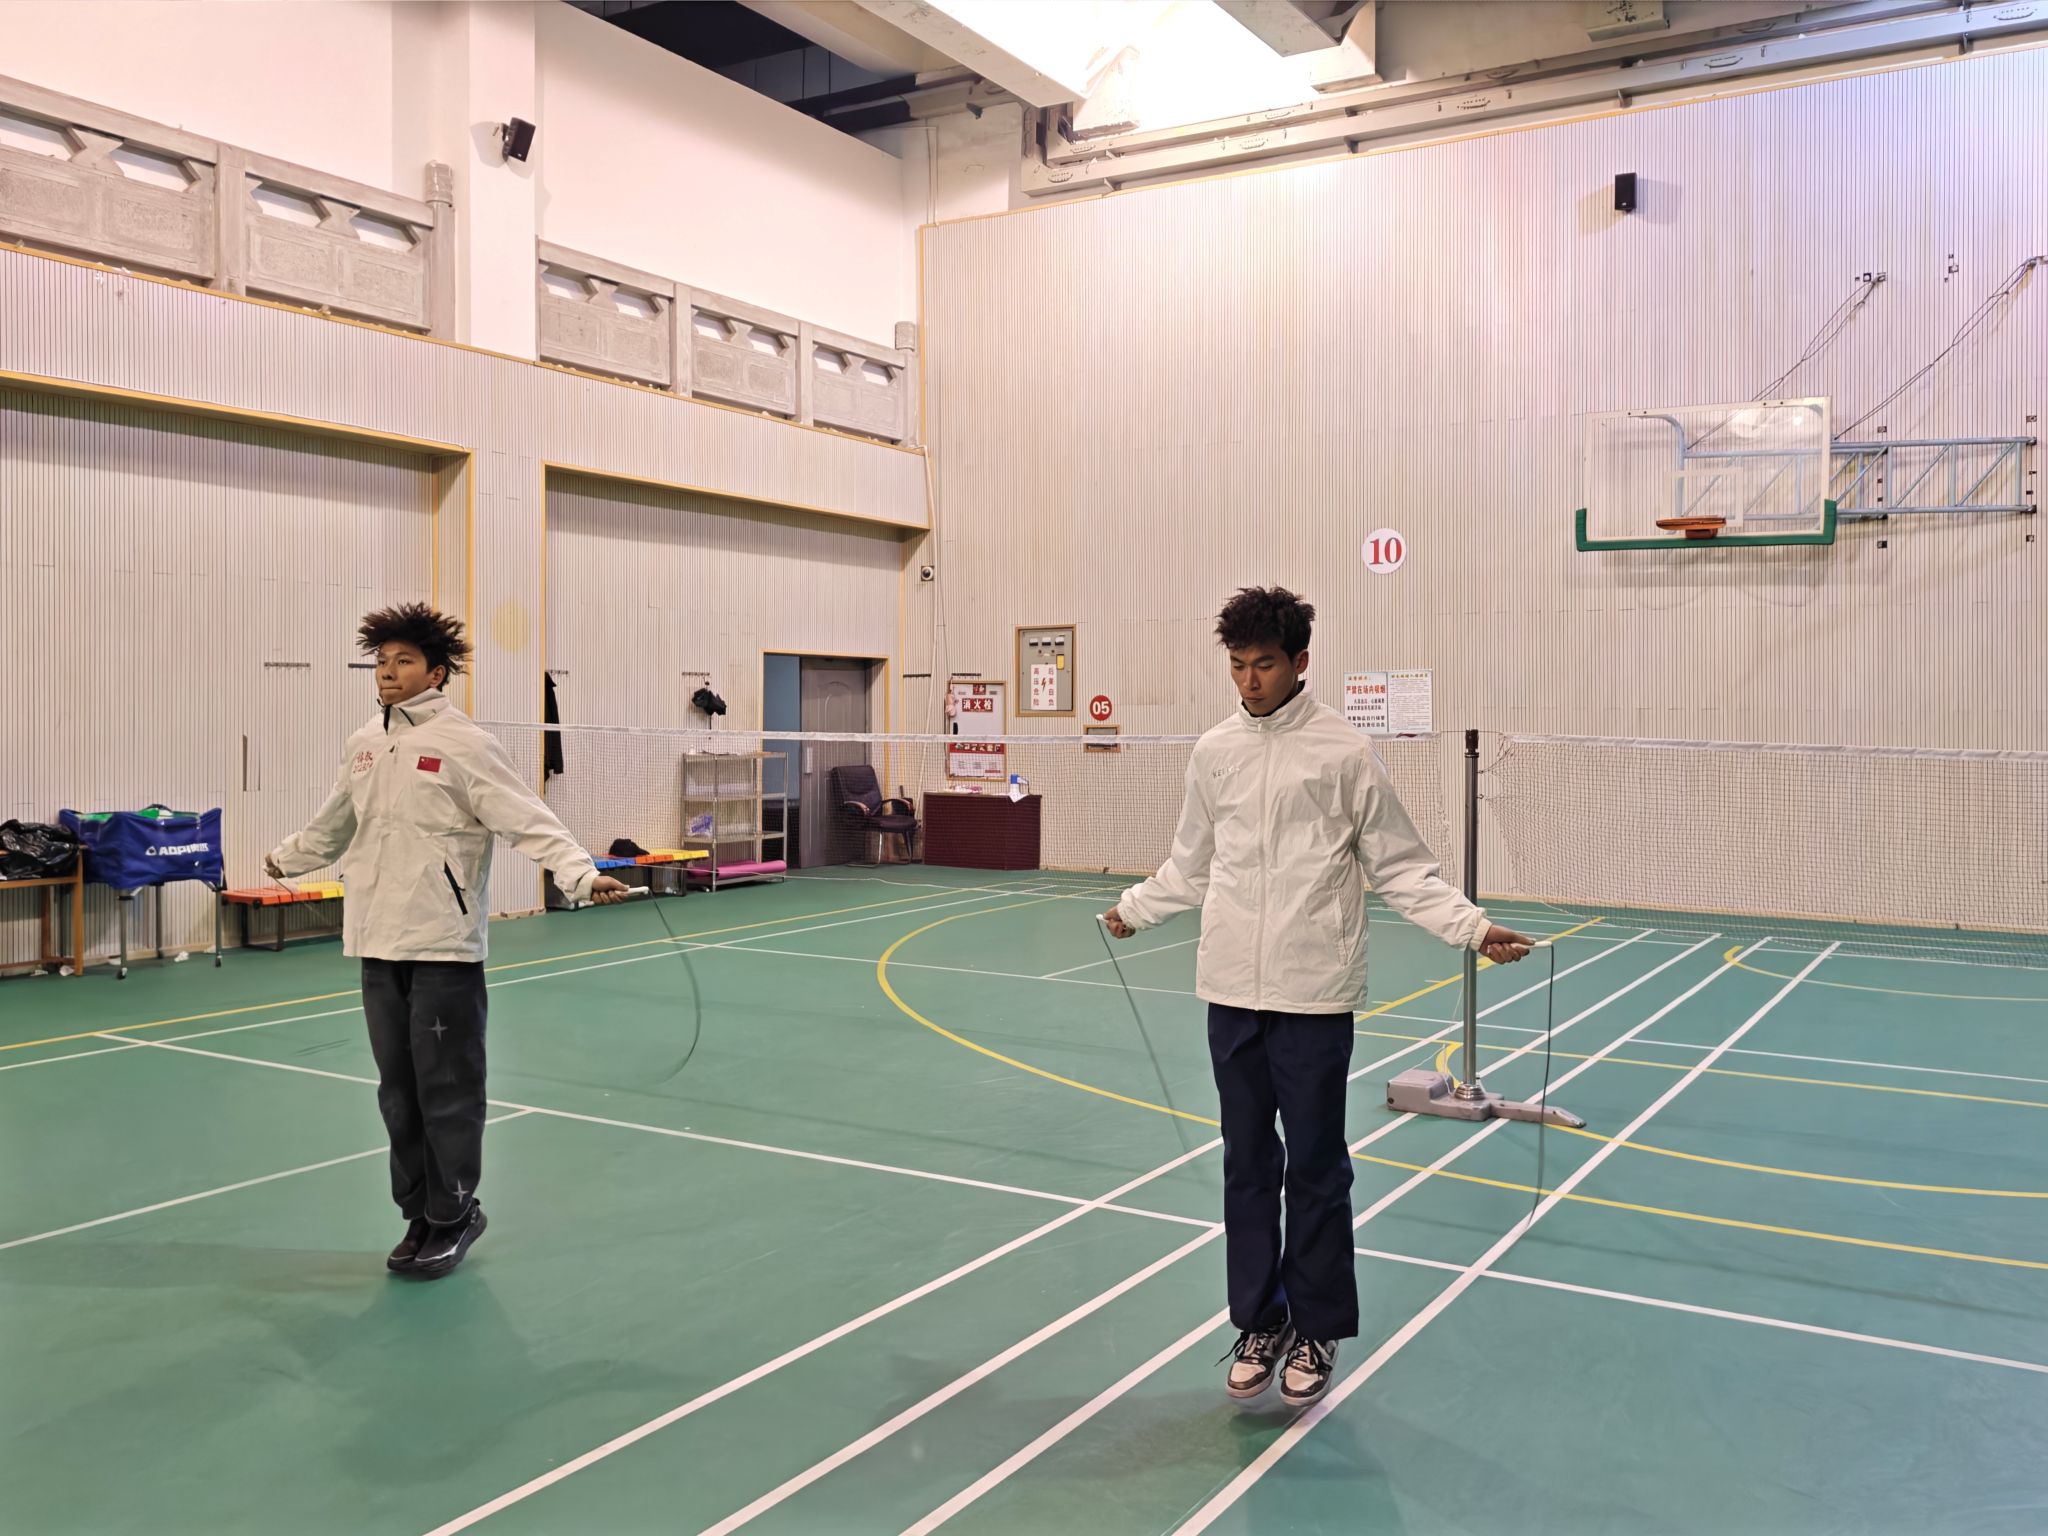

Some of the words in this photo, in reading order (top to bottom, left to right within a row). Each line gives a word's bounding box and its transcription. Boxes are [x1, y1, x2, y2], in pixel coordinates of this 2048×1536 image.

[1368, 537, 1402, 565] 10
[1346, 685, 1385, 694] 严禁在场内吸烟
[963, 699, 992, 710] 消火栓
[1092, 700, 1110, 715] 05
